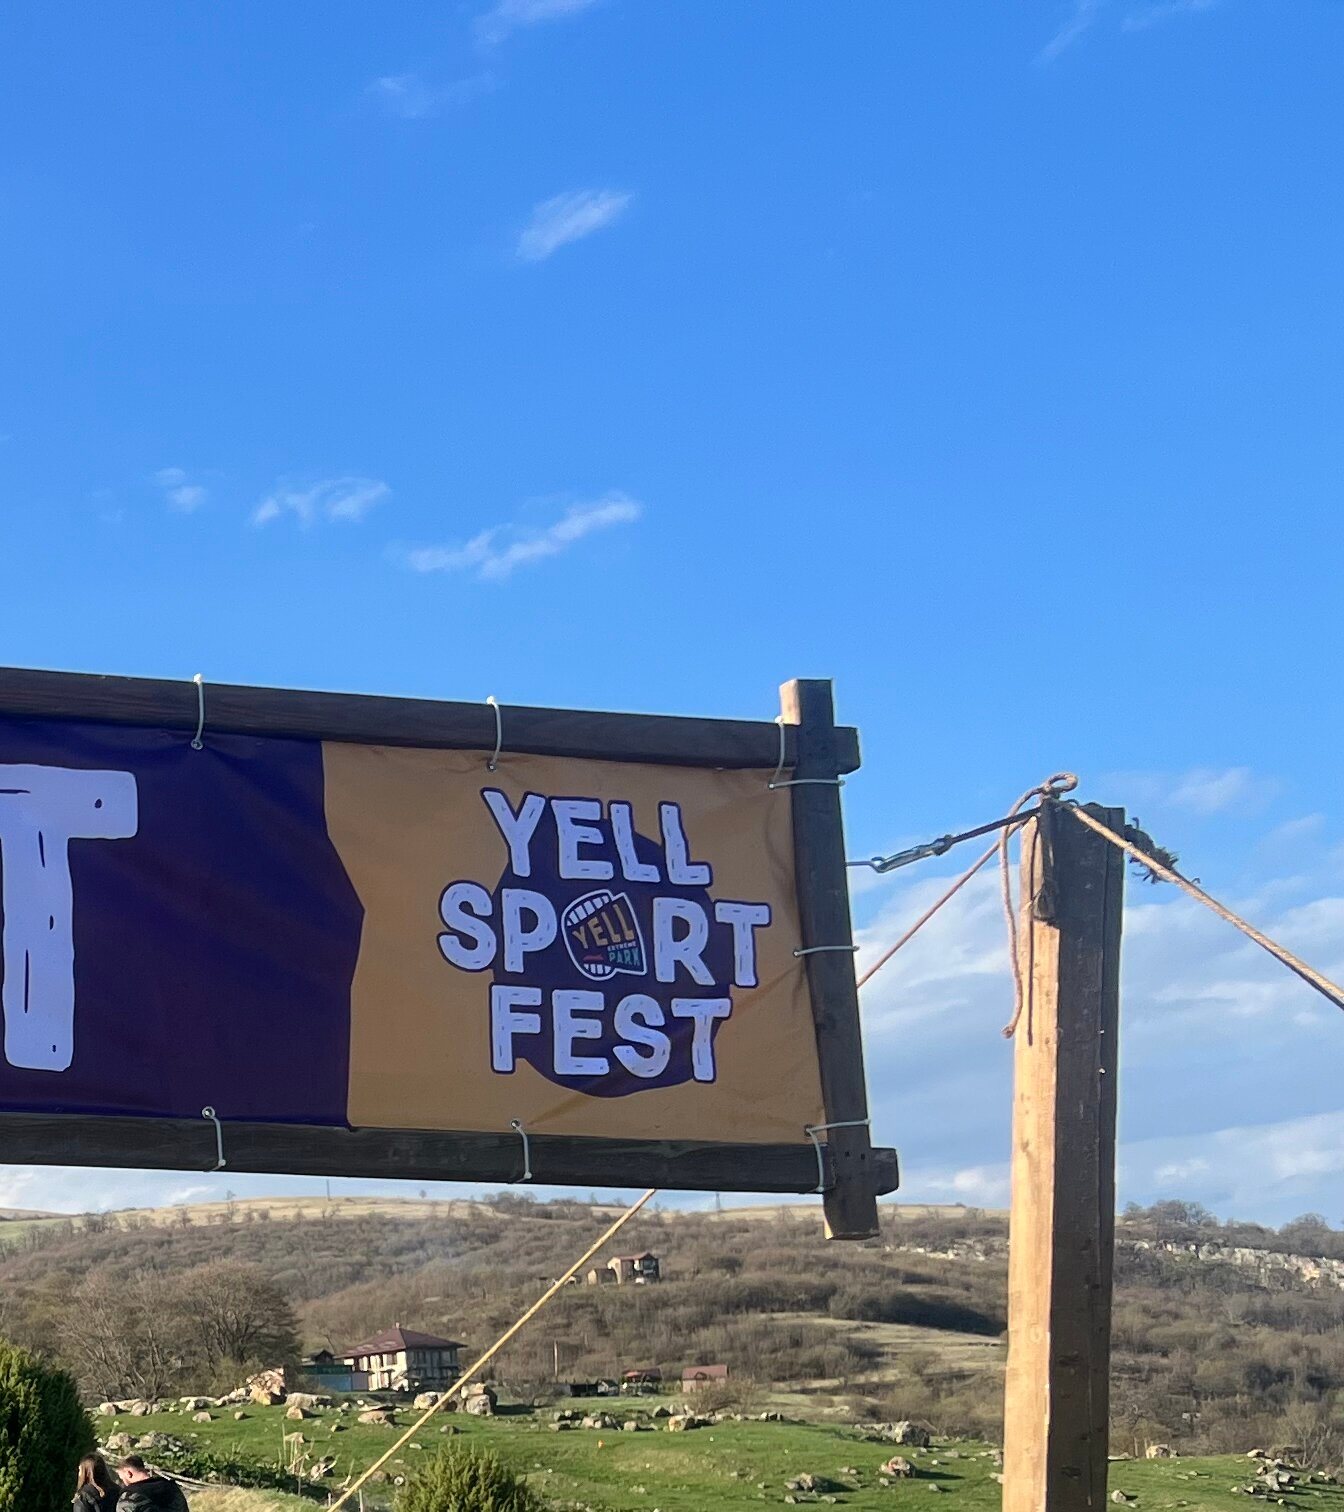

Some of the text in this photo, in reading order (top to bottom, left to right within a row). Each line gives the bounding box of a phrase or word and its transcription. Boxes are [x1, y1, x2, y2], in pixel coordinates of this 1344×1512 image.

[482, 790, 712, 886] YELL
[438, 882, 771, 987] SPORT
[571, 903, 635, 949] YELL
[608, 948, 641, 966] PARK
[491, 985, 732, 1081] FEST
